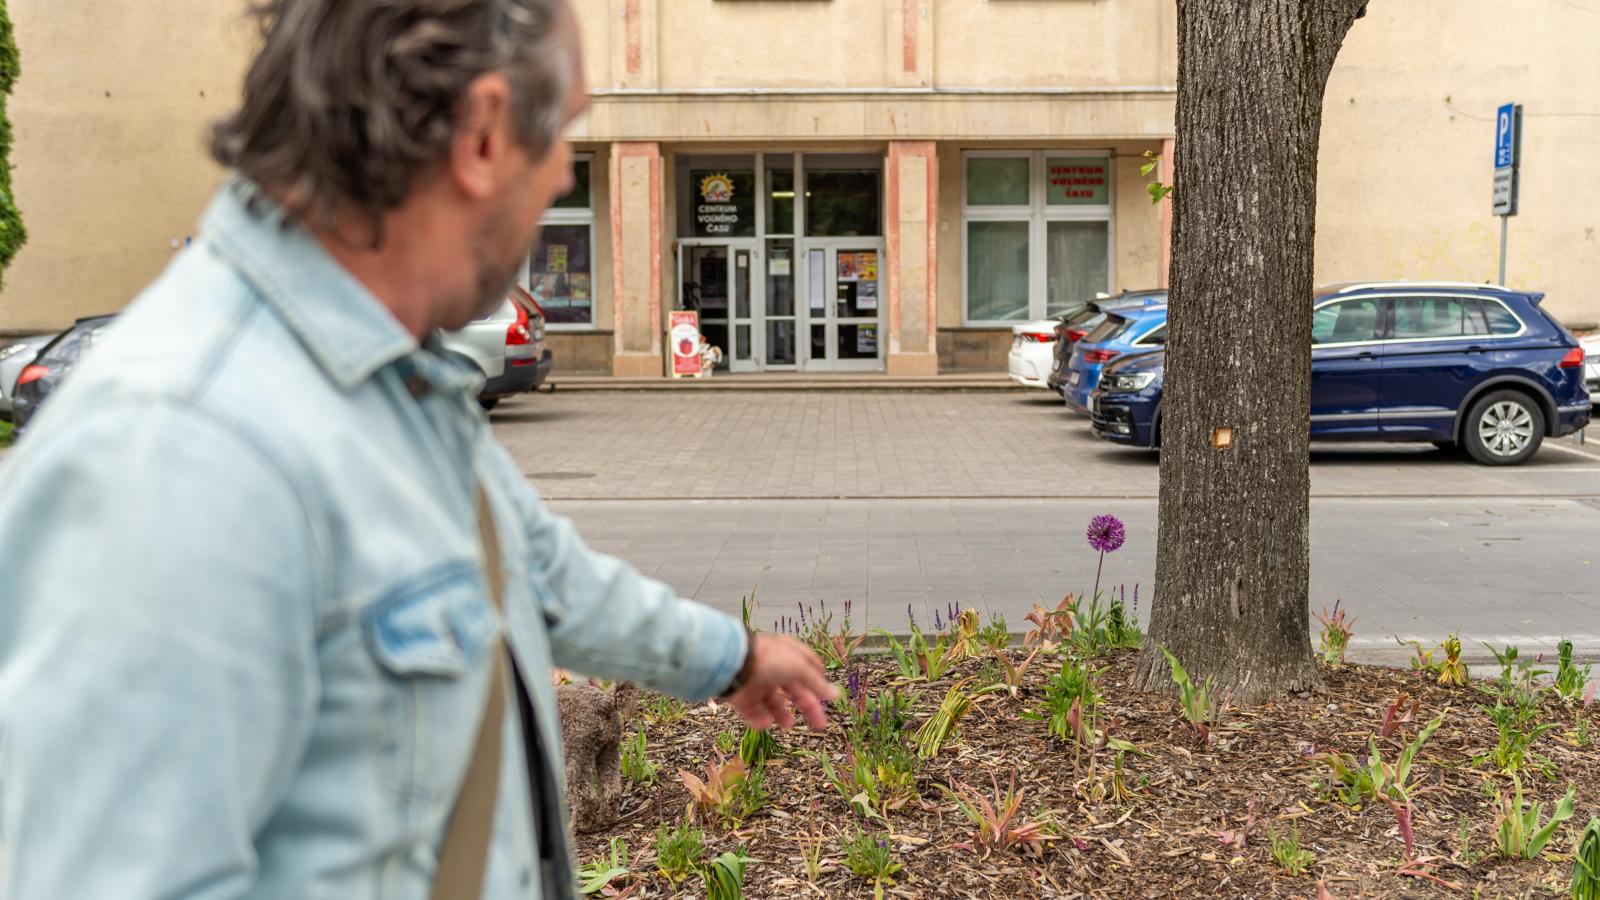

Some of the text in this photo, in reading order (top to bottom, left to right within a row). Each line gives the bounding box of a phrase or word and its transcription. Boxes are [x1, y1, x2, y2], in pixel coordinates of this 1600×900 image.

[1500, 112, 1509, 148] P
[1051, 166, 1104, 174] CENTRUM
[1065, 188, 1093, 197] ČASU
[698, 204, 737, 213] CENTRUM
[706, 223, 730, 233] ČASU
